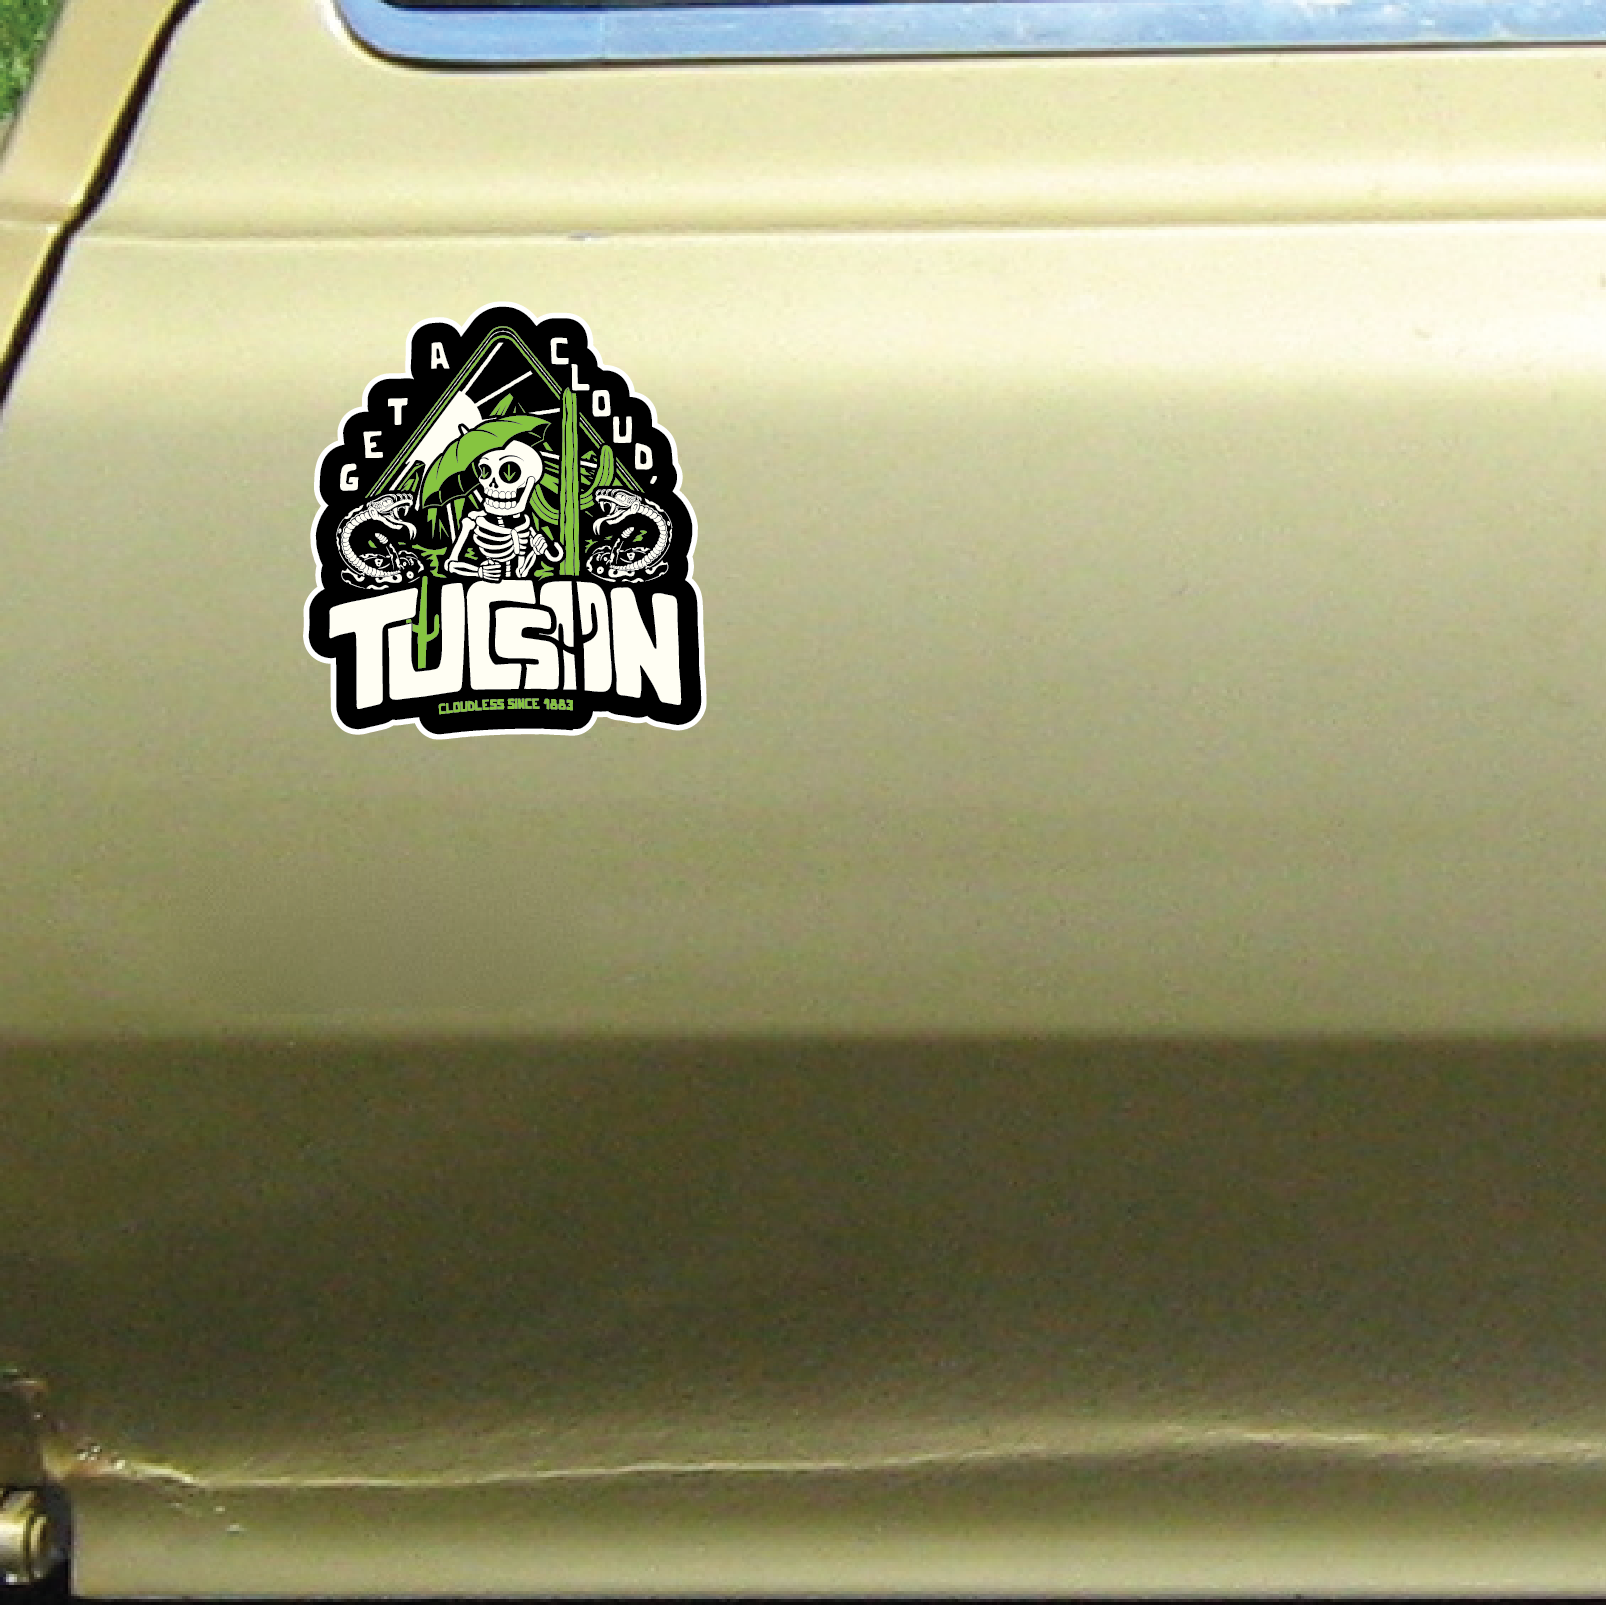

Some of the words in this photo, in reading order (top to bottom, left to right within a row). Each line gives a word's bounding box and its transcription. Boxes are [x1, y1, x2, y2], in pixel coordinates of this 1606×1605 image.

[340, 397, 408, 491] GET
[430, 341, 450, 370] A
[329, 579, 682, 710] TUCSON
[438, 698, 505, 715] CLOUDLESS
[507, 697, 541, 710] SINCE
